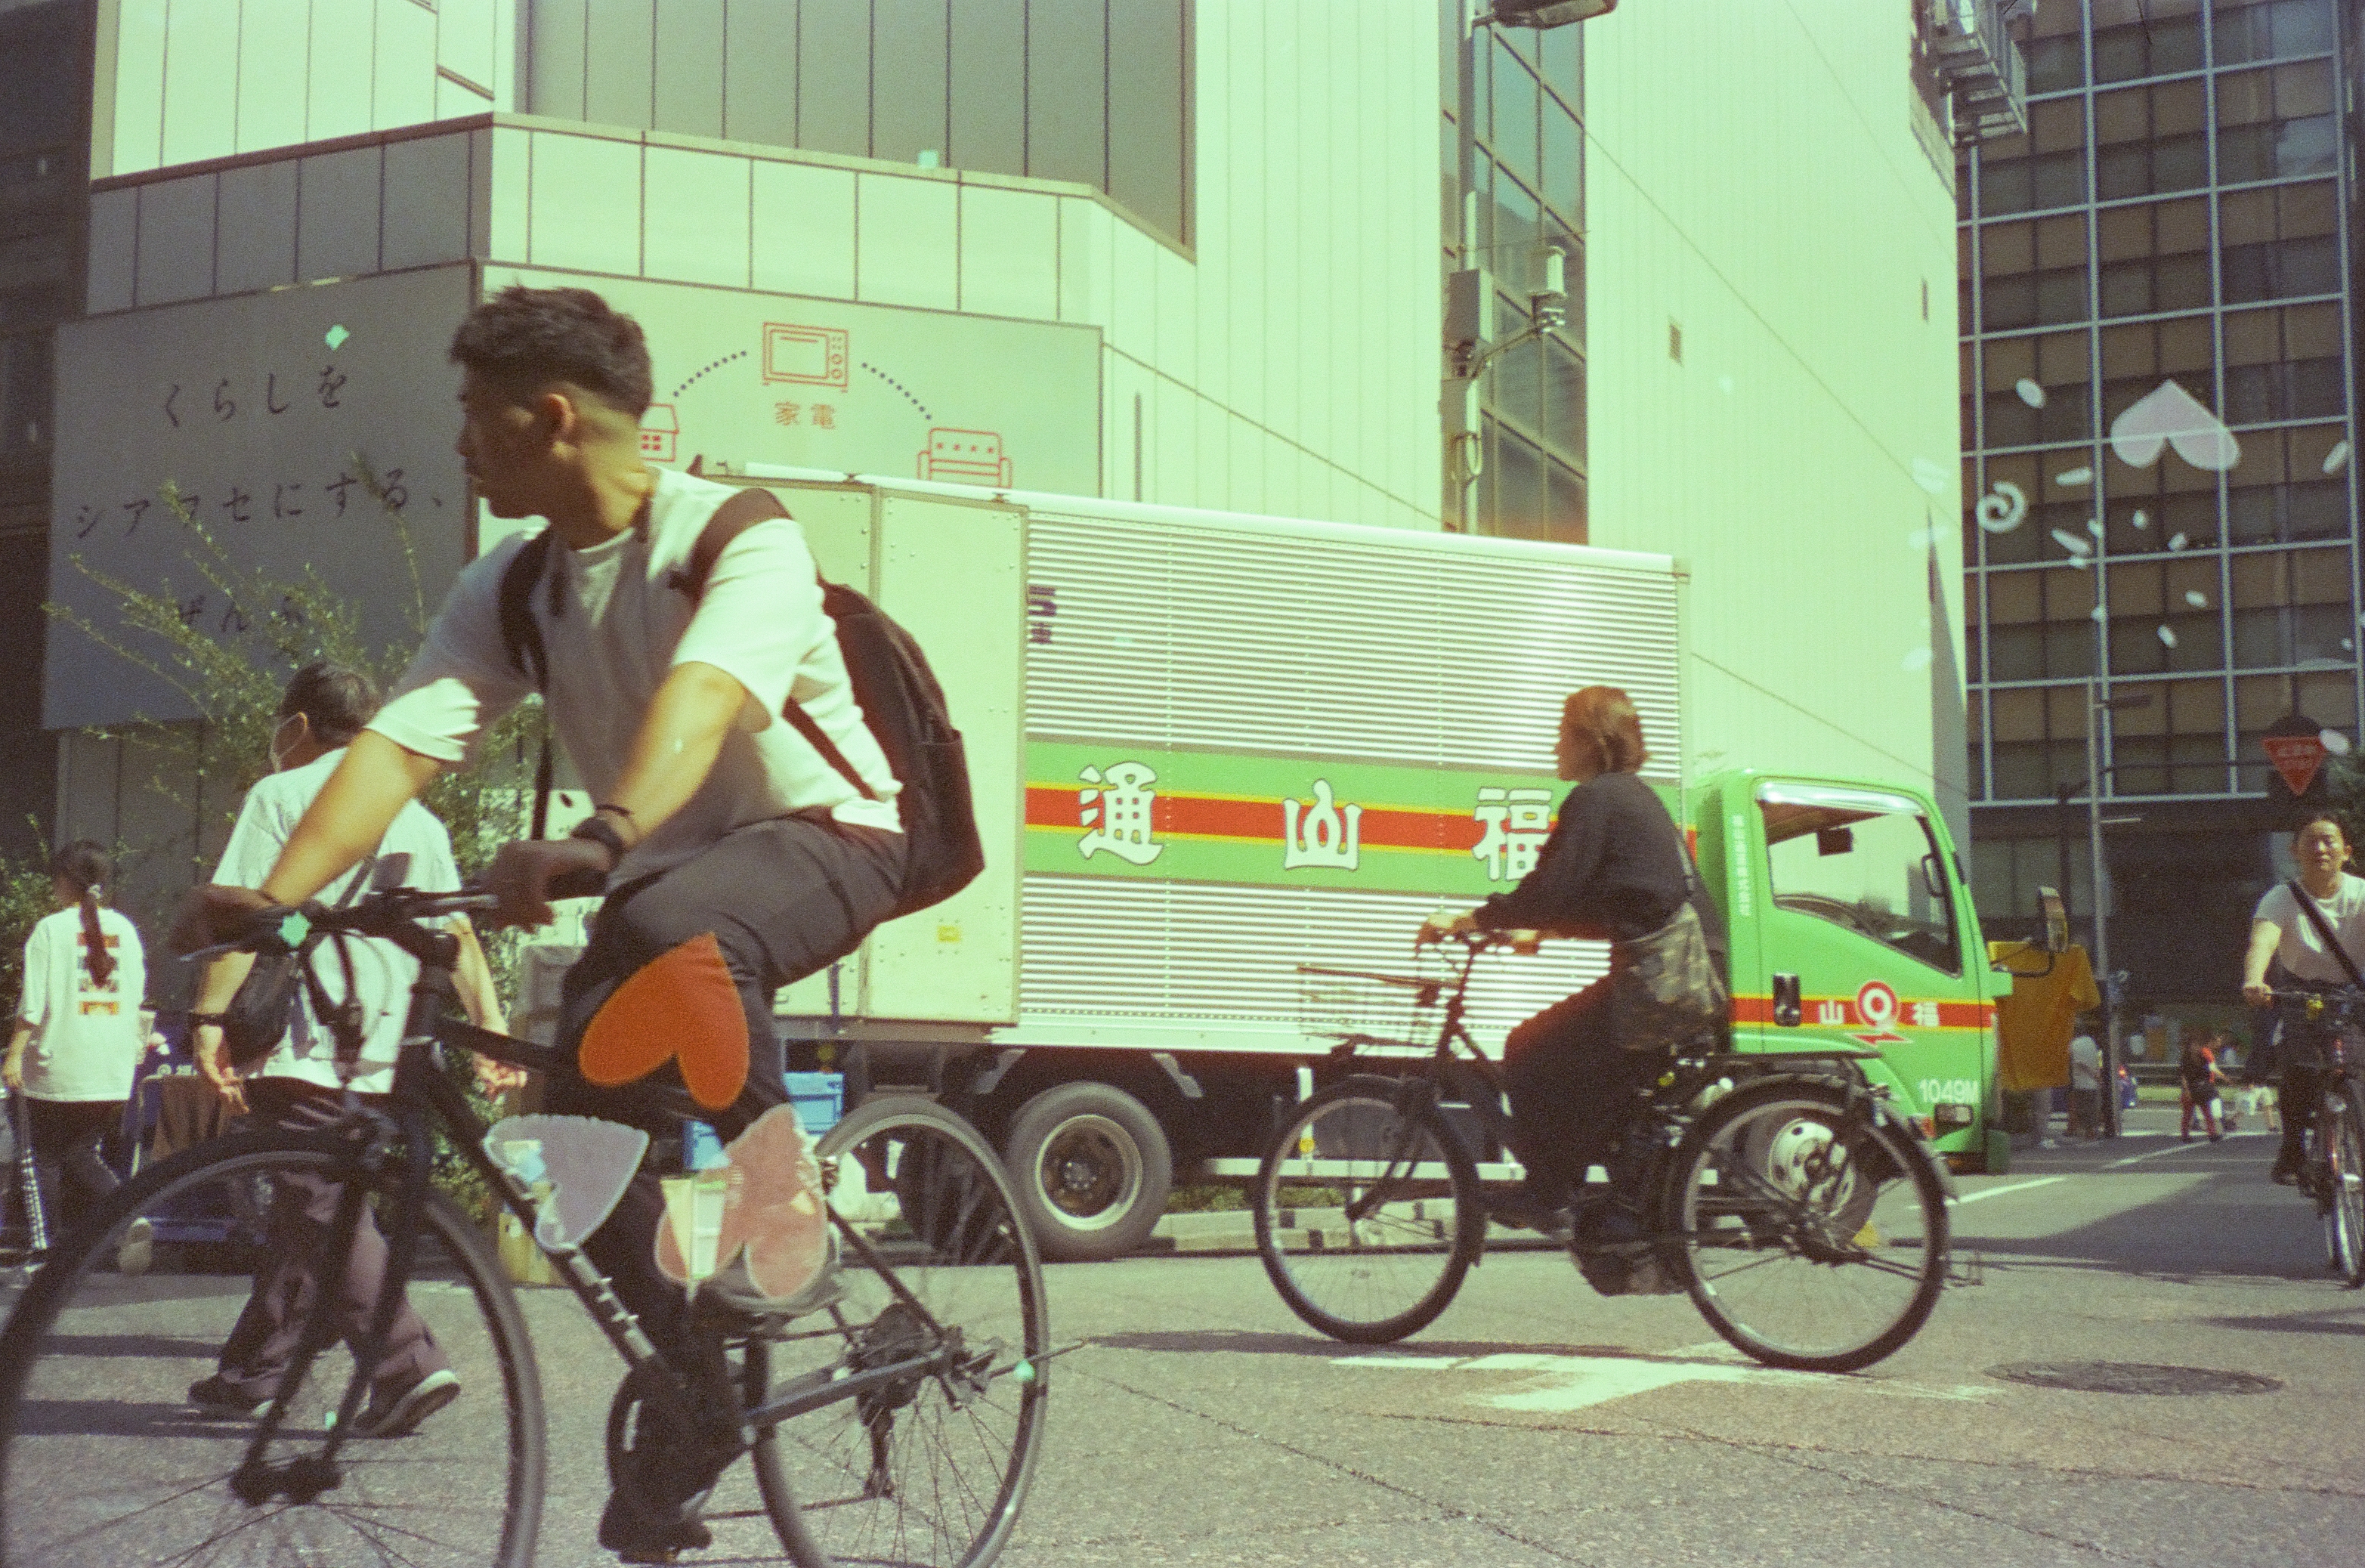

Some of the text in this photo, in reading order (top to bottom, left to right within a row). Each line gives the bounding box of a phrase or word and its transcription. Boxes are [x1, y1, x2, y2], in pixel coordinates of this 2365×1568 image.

[165, 365, 348, 428] くらしを
[774, 401, 836, 430] 家電
